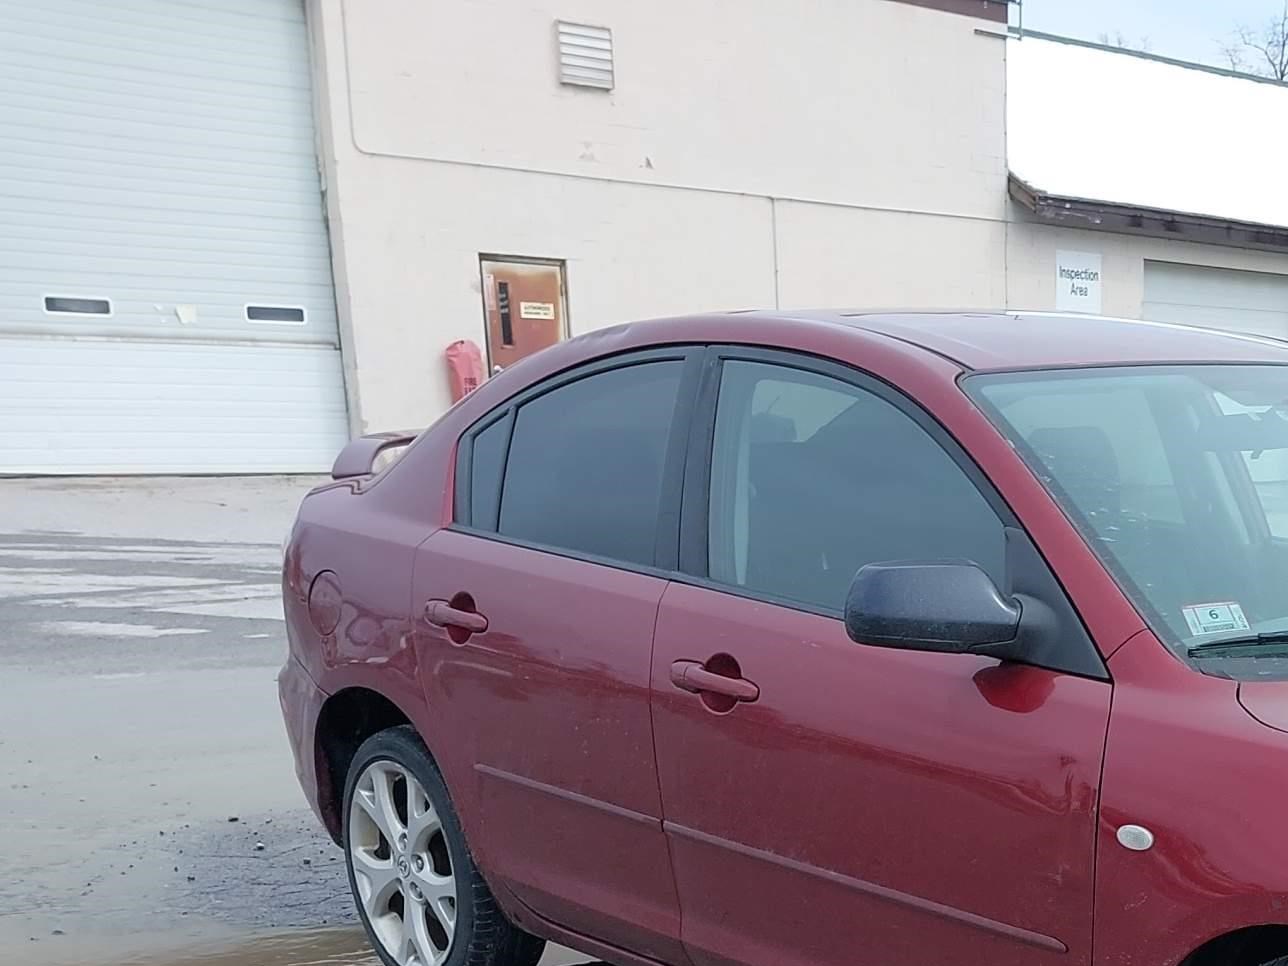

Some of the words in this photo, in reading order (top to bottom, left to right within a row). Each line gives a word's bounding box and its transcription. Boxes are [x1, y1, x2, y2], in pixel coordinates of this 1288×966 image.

[1059, 265, 1099, 281] Inspection
[1070, 282, 1088, 296] Area
[1208, 609, 1219, 620] 6
